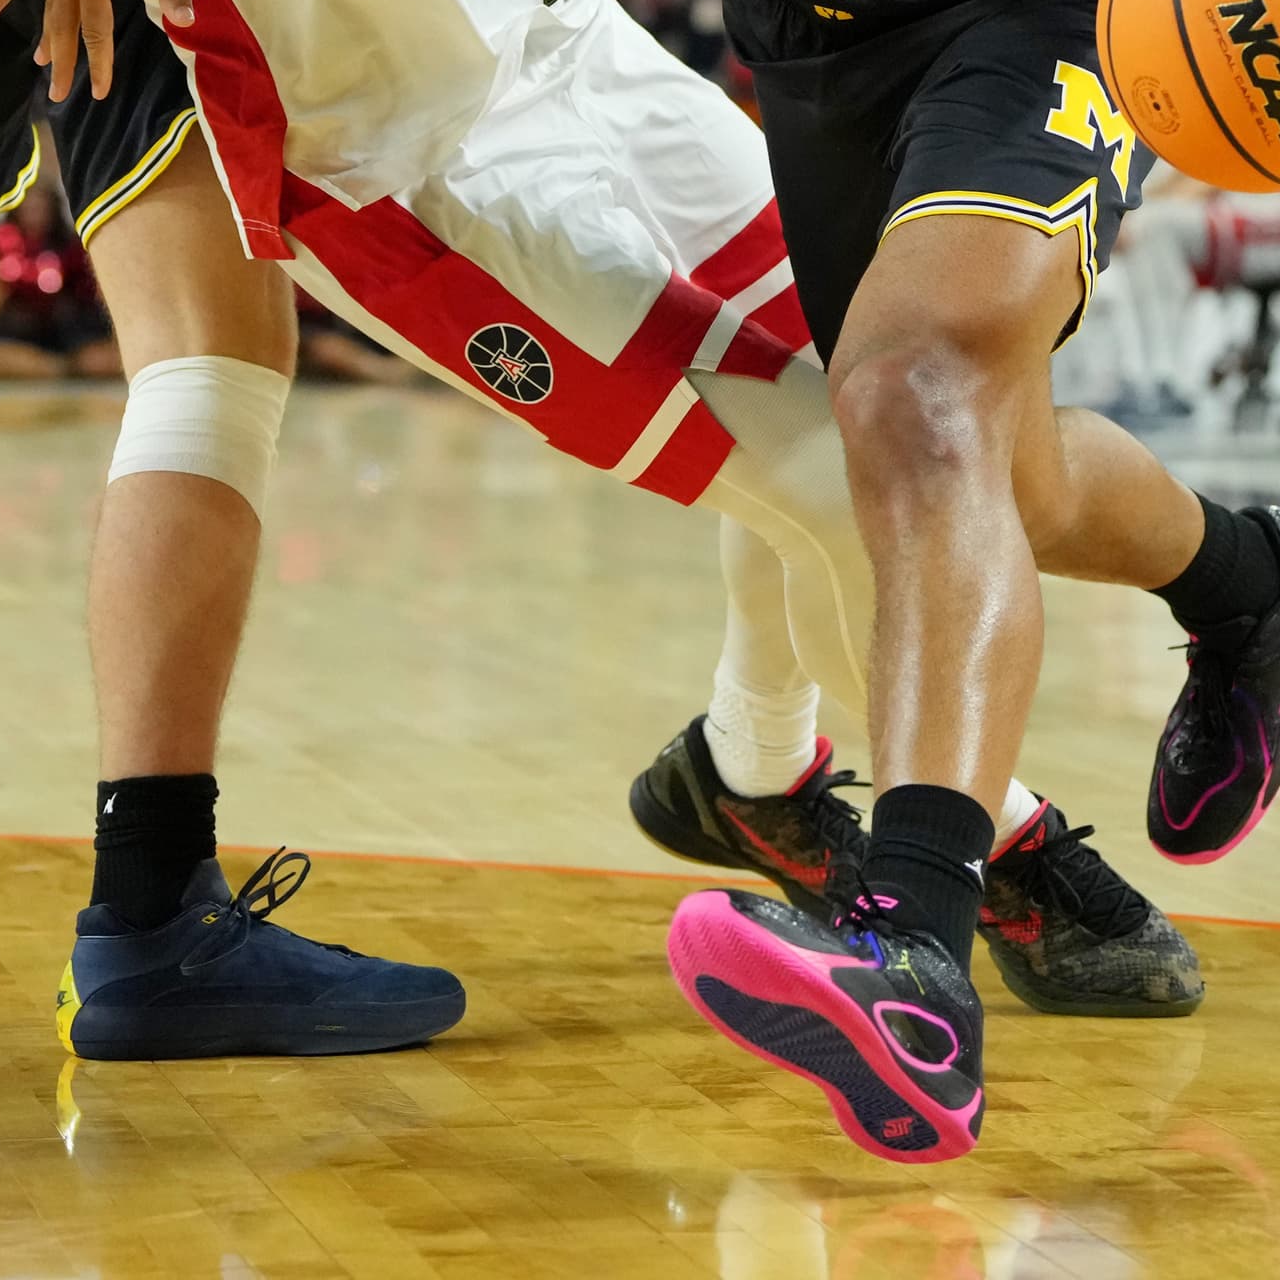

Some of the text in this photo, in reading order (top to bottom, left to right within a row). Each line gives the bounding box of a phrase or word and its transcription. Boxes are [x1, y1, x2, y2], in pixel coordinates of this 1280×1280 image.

[1044, 59, 1136, 204] M
[1205, 8, 1274, 146] OFFICIAL GAME BALL
[490, 348, 529, 385] A
